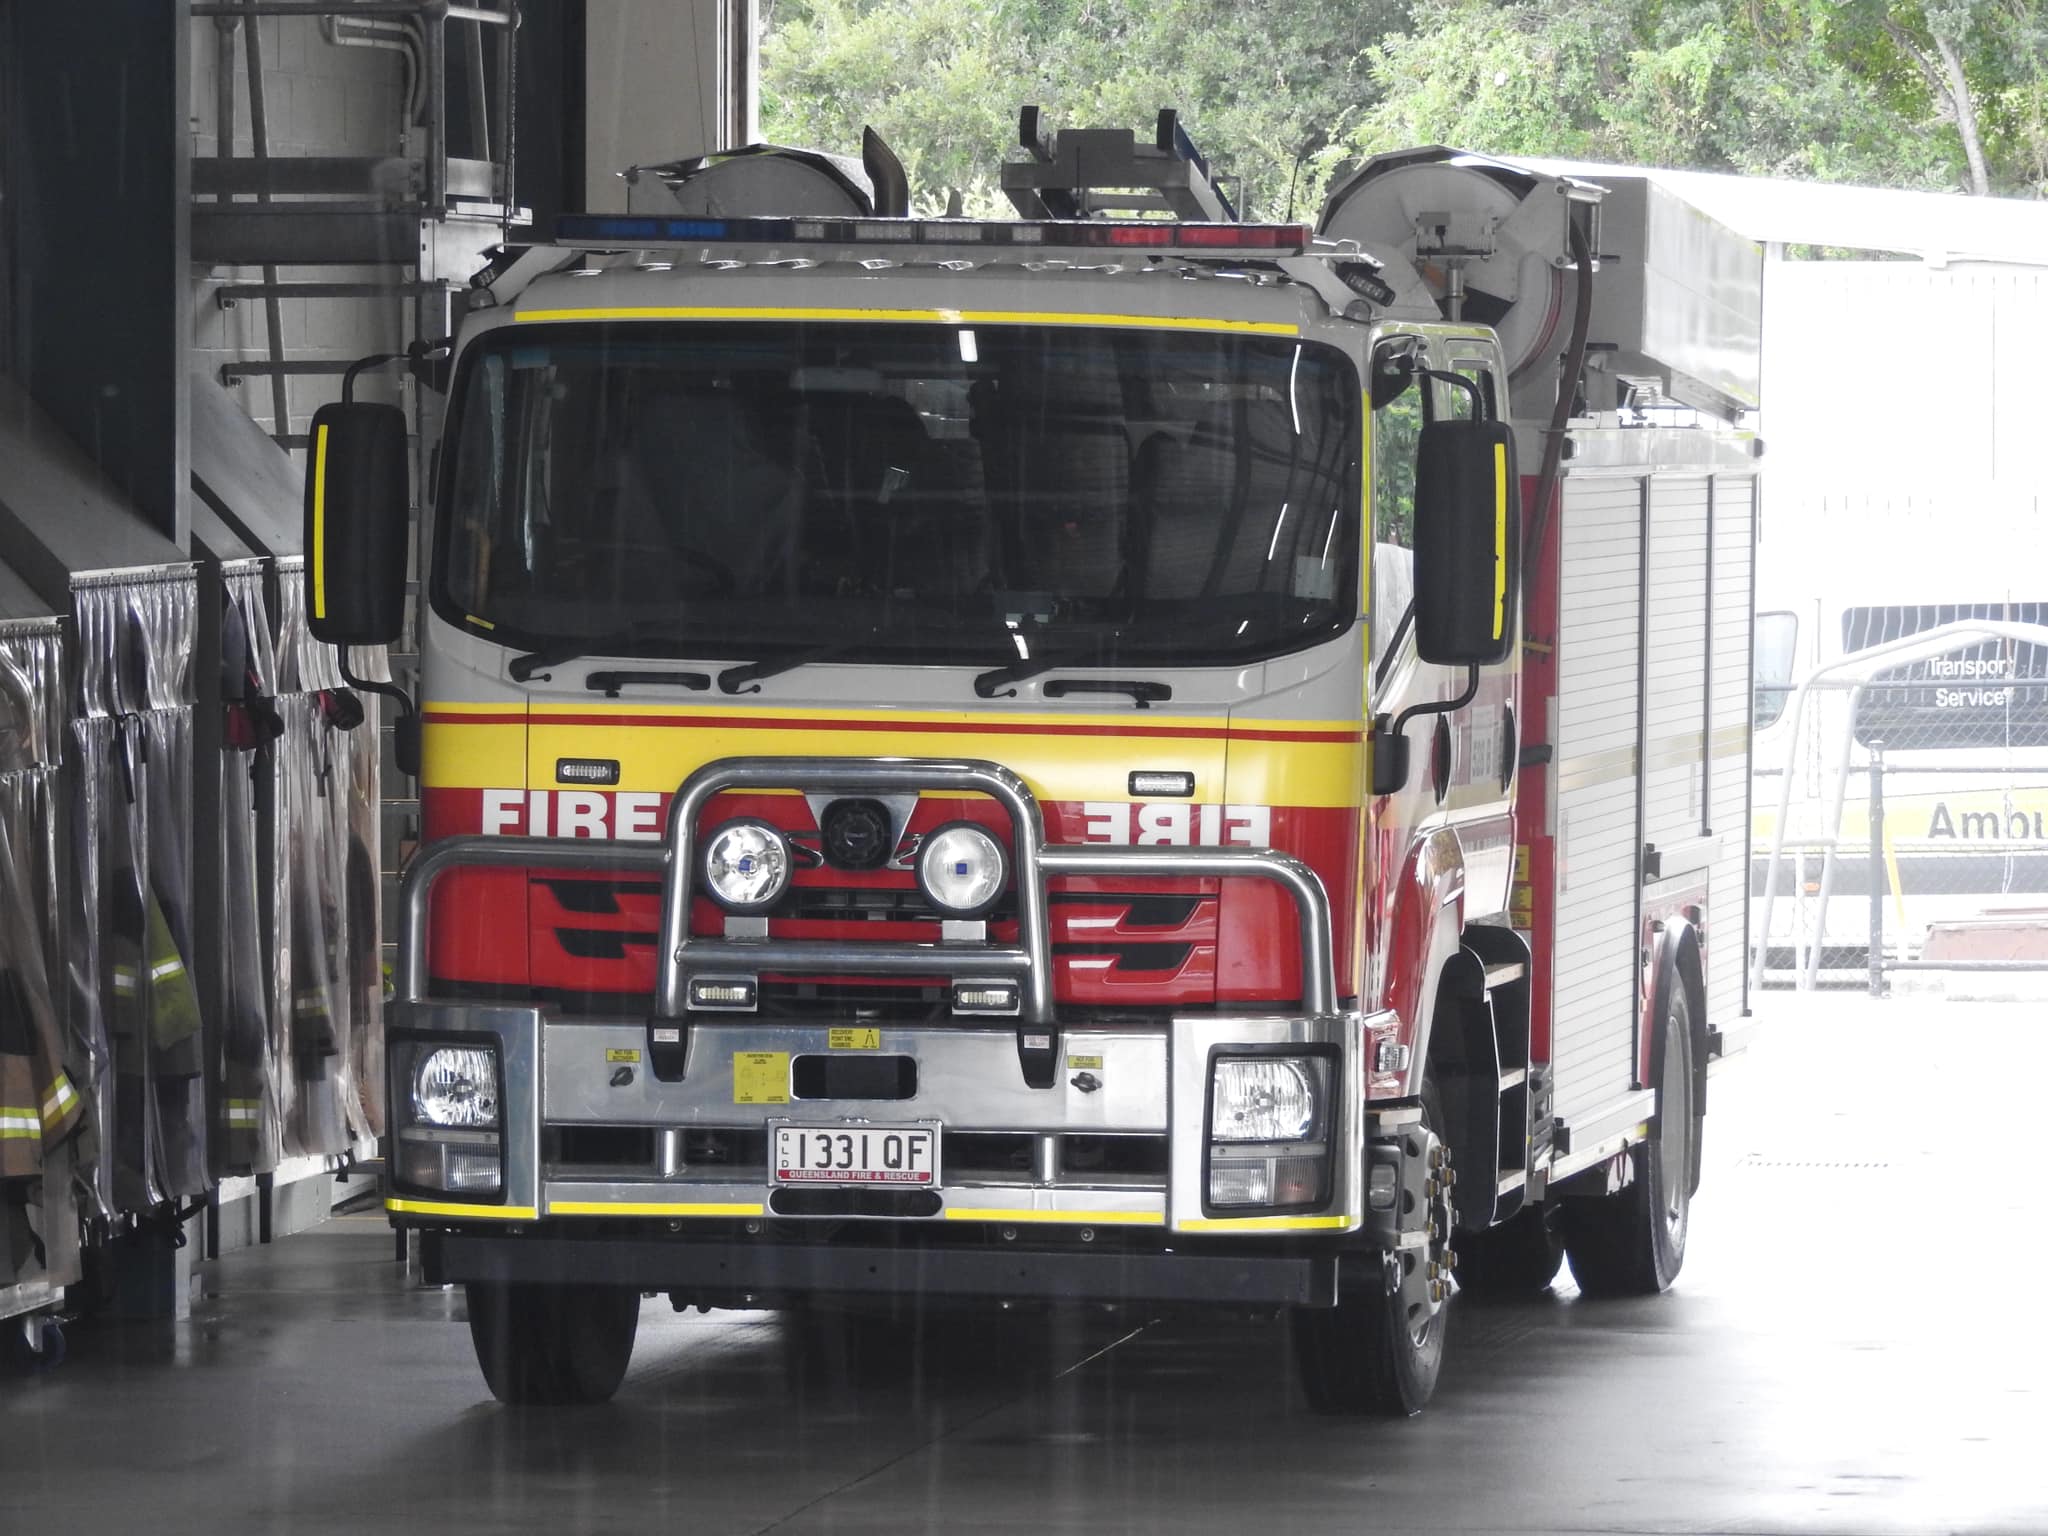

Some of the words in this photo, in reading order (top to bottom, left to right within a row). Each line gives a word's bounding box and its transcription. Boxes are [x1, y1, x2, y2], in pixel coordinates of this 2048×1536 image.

[1935, 687, 2004, 707] Service
[482, 789, 661, 840] FIRE
[788, 1170, 850, 1180] QUEENSLAND
[851, 1171, 872, 1180] FIRE
[874, 1172, 882, 1180] &
[884, 1172, 920, 1181] RESCUE
